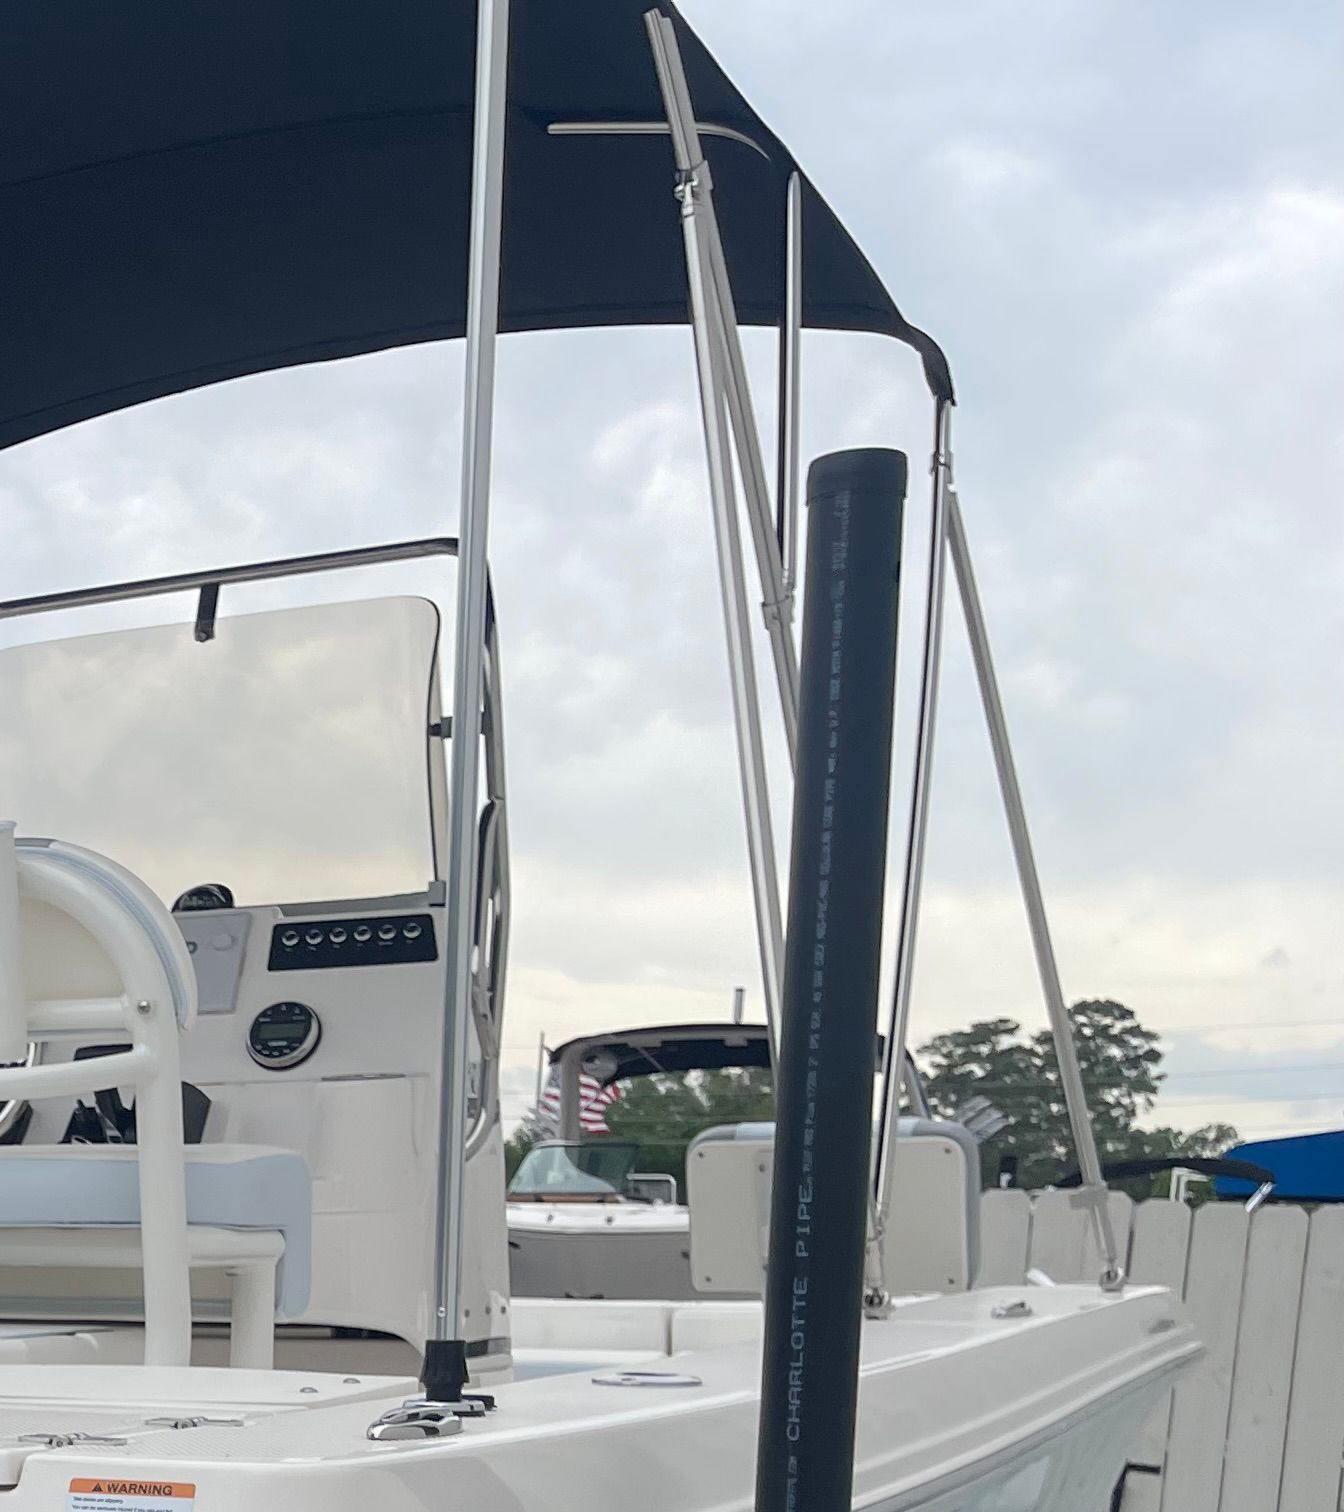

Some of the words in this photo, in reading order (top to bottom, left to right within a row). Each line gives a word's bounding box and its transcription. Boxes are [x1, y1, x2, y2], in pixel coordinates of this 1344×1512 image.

[795, 1184, 812, 1258] PIPE
[786, 1277, 808, 1441] CHARLOTTE
[108, 1484, 173, 1496] WARNING
